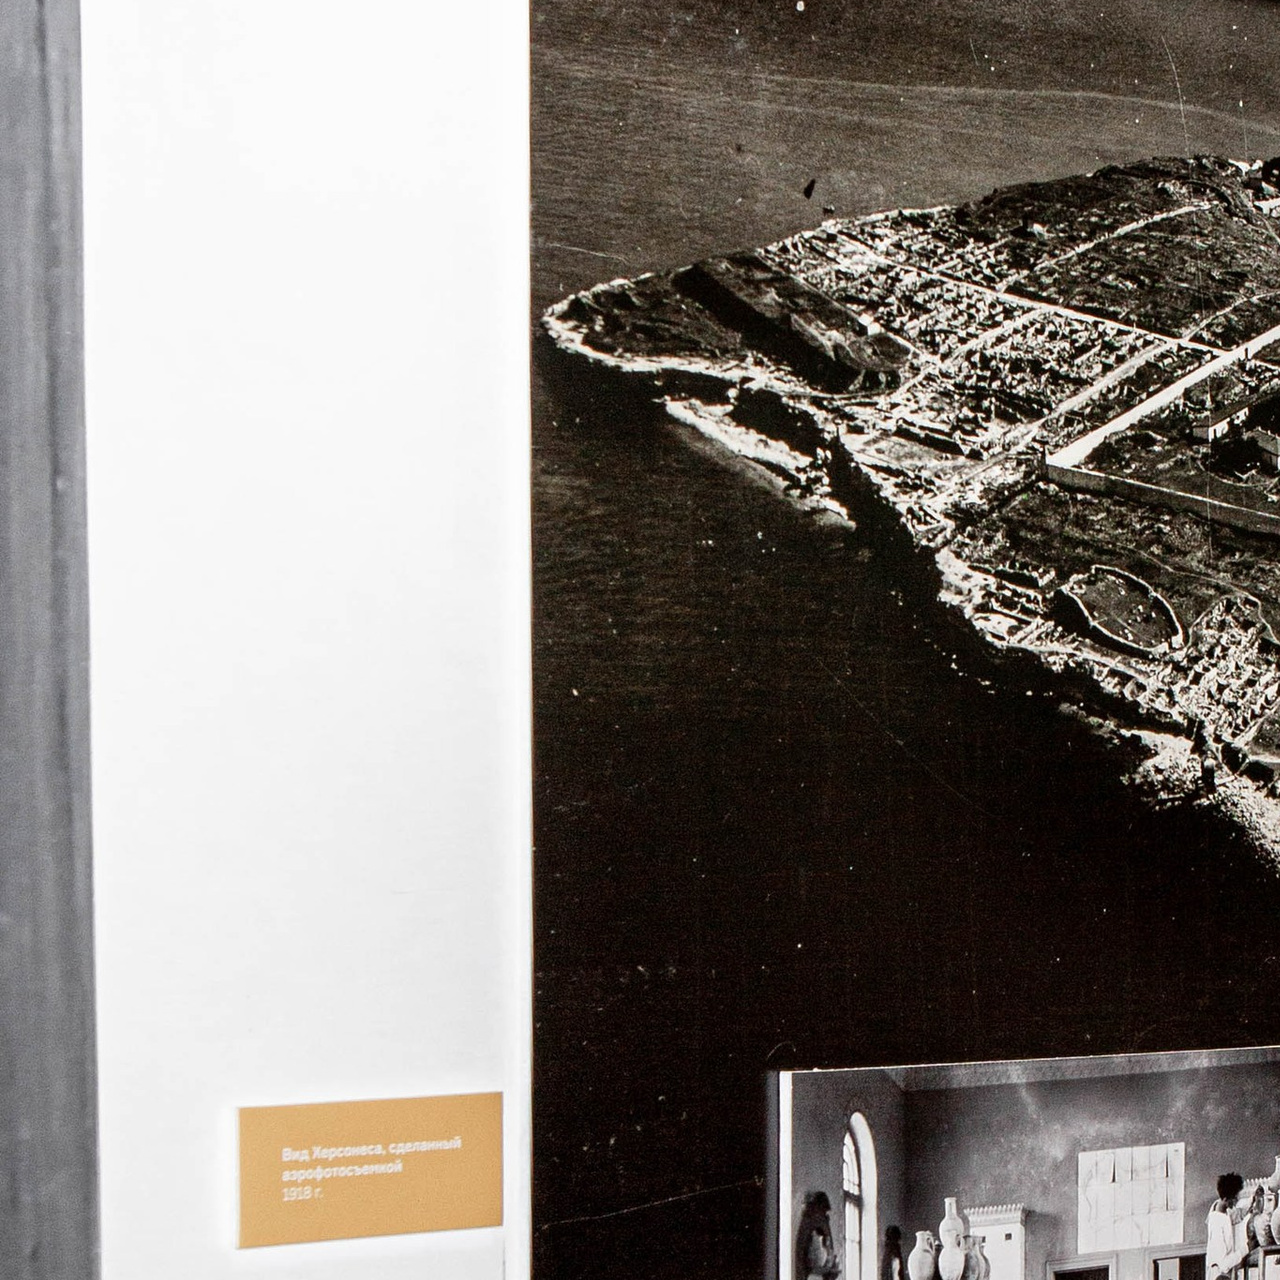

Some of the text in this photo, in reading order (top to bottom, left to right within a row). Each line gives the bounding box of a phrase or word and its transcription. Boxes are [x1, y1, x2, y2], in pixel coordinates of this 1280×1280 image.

[281, 1136, 462, 1162] Вид Херсонеса, сделанный
